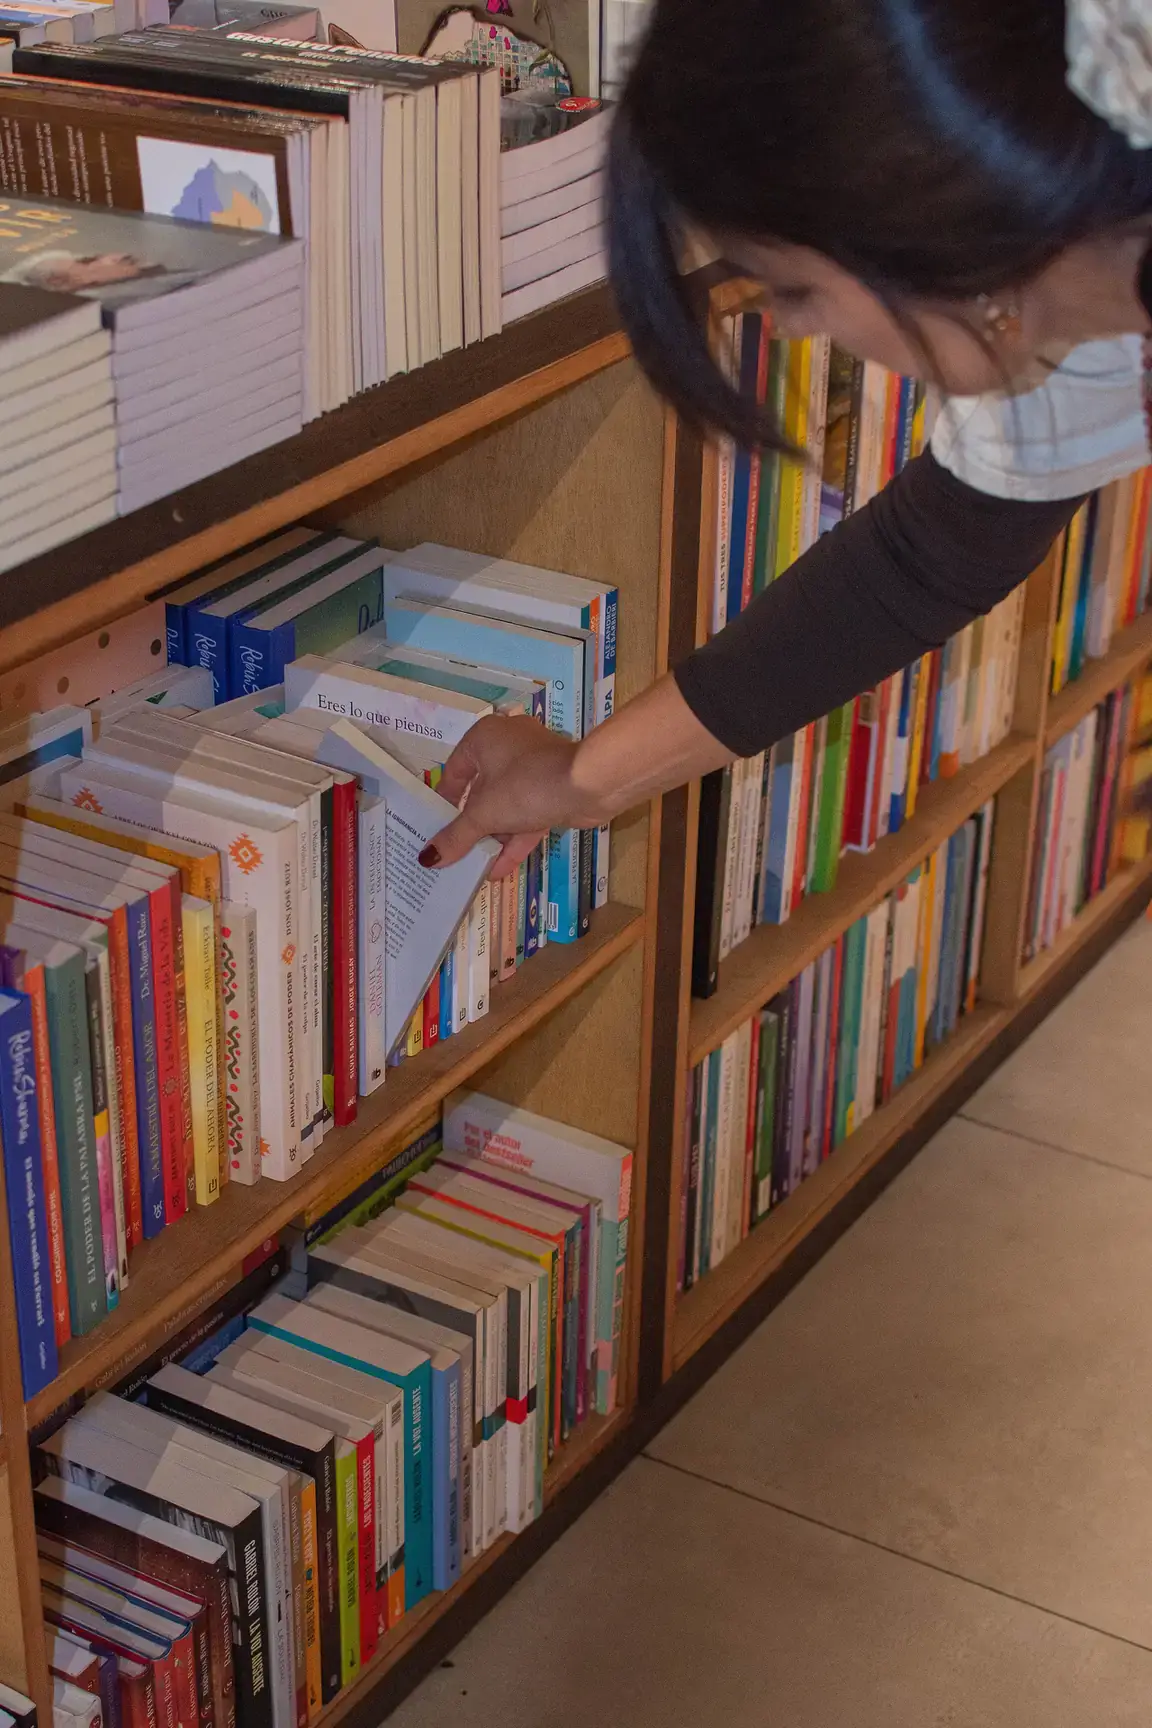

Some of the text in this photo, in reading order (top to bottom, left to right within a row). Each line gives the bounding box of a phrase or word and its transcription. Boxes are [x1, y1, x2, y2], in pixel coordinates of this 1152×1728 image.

[317, 693, 443, 740] Eres lo que piensas
[137, 911, 149, 978] Miguel Ruiz
[477, 917, 485, 930] lo
[477, 931, 485, 957] Eres
[203, 925, 212, 991] Eckhart Tolle
[287, 1006, 293, 1019] DE
[285, 1020, 295, 1082] CHAMÁNICOS
[143, 1021, 161, 1181] LA MAESTRÍA DEL AMOR
[204, 1019, 216, 1154] EL PODER DEL AHORA
[74, 1106, 89, 1168] PALABRA
[484, 1128, 491, 1140] el
[79, 1168, 91, 1191] LA
[28, 1208, 36, 1228] que
[80, 1193, 92, 1213] DE
[82, 1217, 96, 1262] PODER
[86, 1264, 97, 1283] EL
[412, 1385, 421, 1425] AUSENTE
[412, 1442, 421, 1456] LA
[244, 1540, 261, 1617] GABRIEL ROLÓN
[220, 1581, 232, 1667] RHONDA BYRNE
[199, 1630, 210, 1697] RHONDA BYRNE
[249, 1617, 265, 1697] LA VOZ AUSENTE
[163, 1670, 172, 1702] BYRNE
[186, 1647, 196, 1719] RHONDA BYRNE
